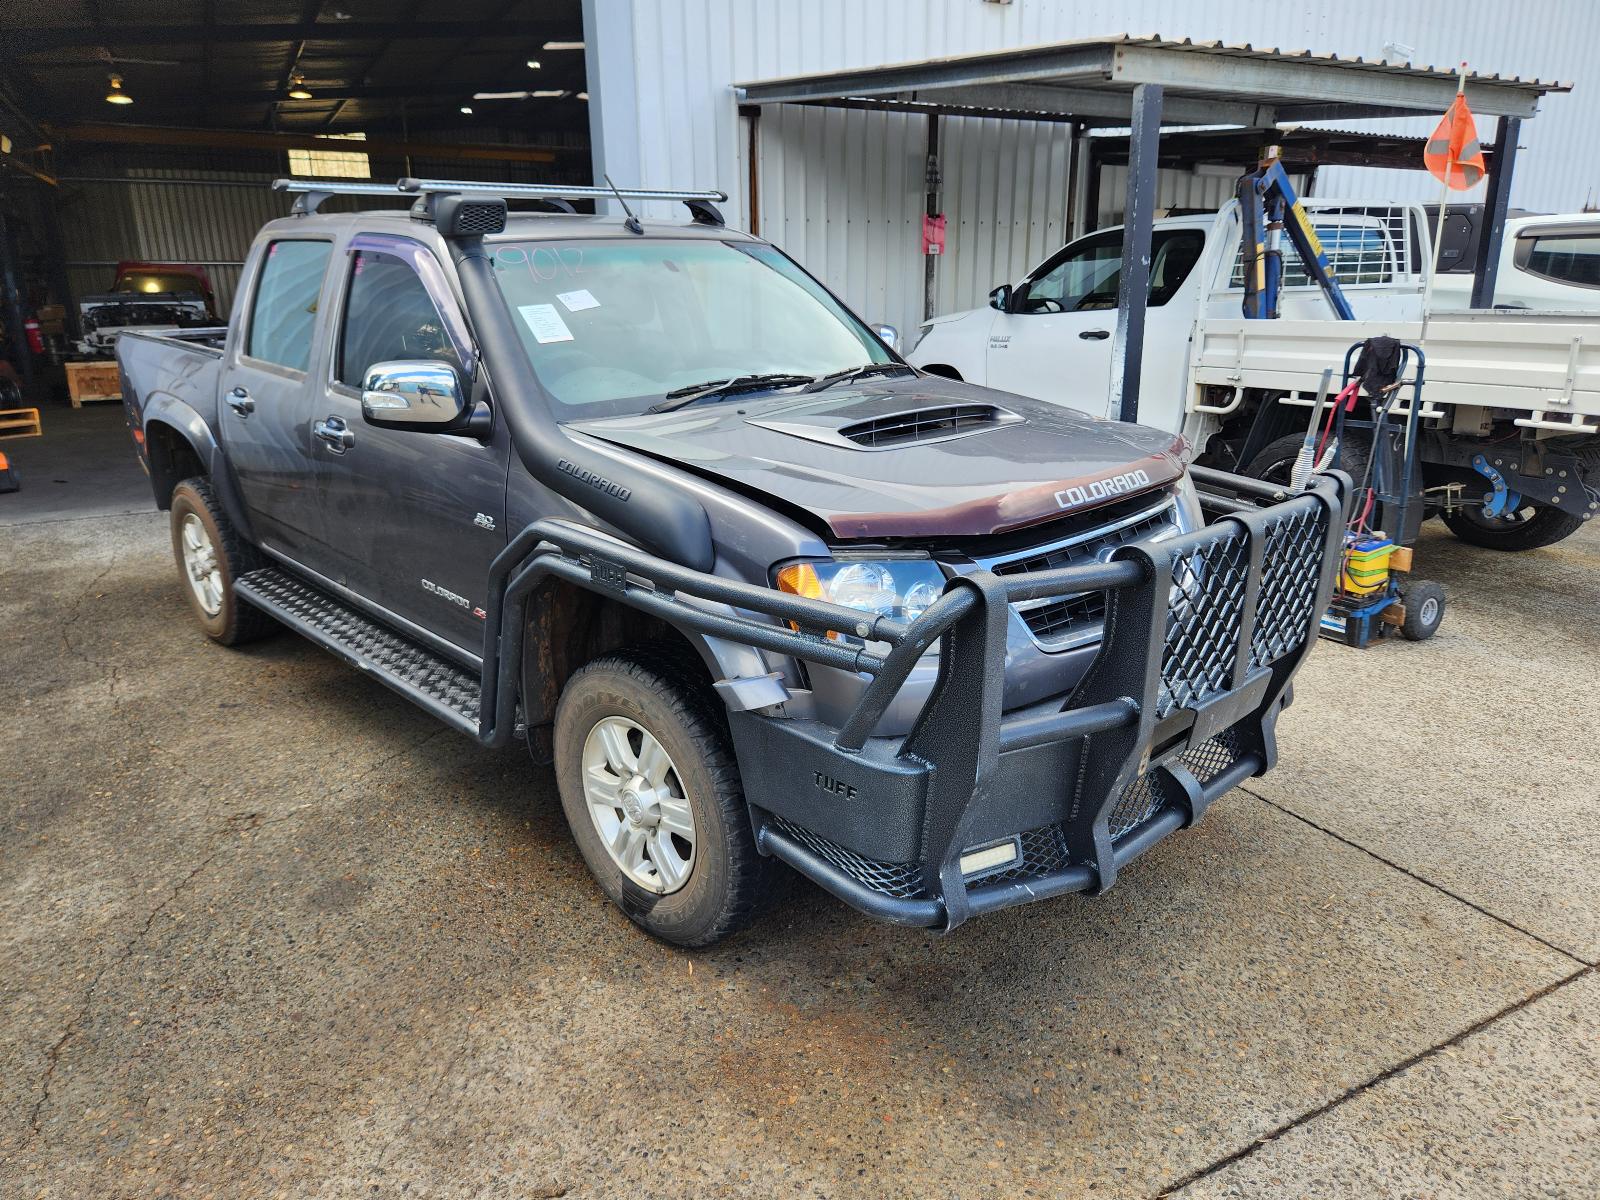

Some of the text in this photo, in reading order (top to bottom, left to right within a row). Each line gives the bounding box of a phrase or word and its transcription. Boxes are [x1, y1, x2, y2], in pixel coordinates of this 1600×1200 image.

[556, 458, 632, 502] COLORADO
[1054, 469, 1150, 509] COLORADO
[421, 578, 470, 609] COLORADO
[812, 769, 858, 801] TUFF
